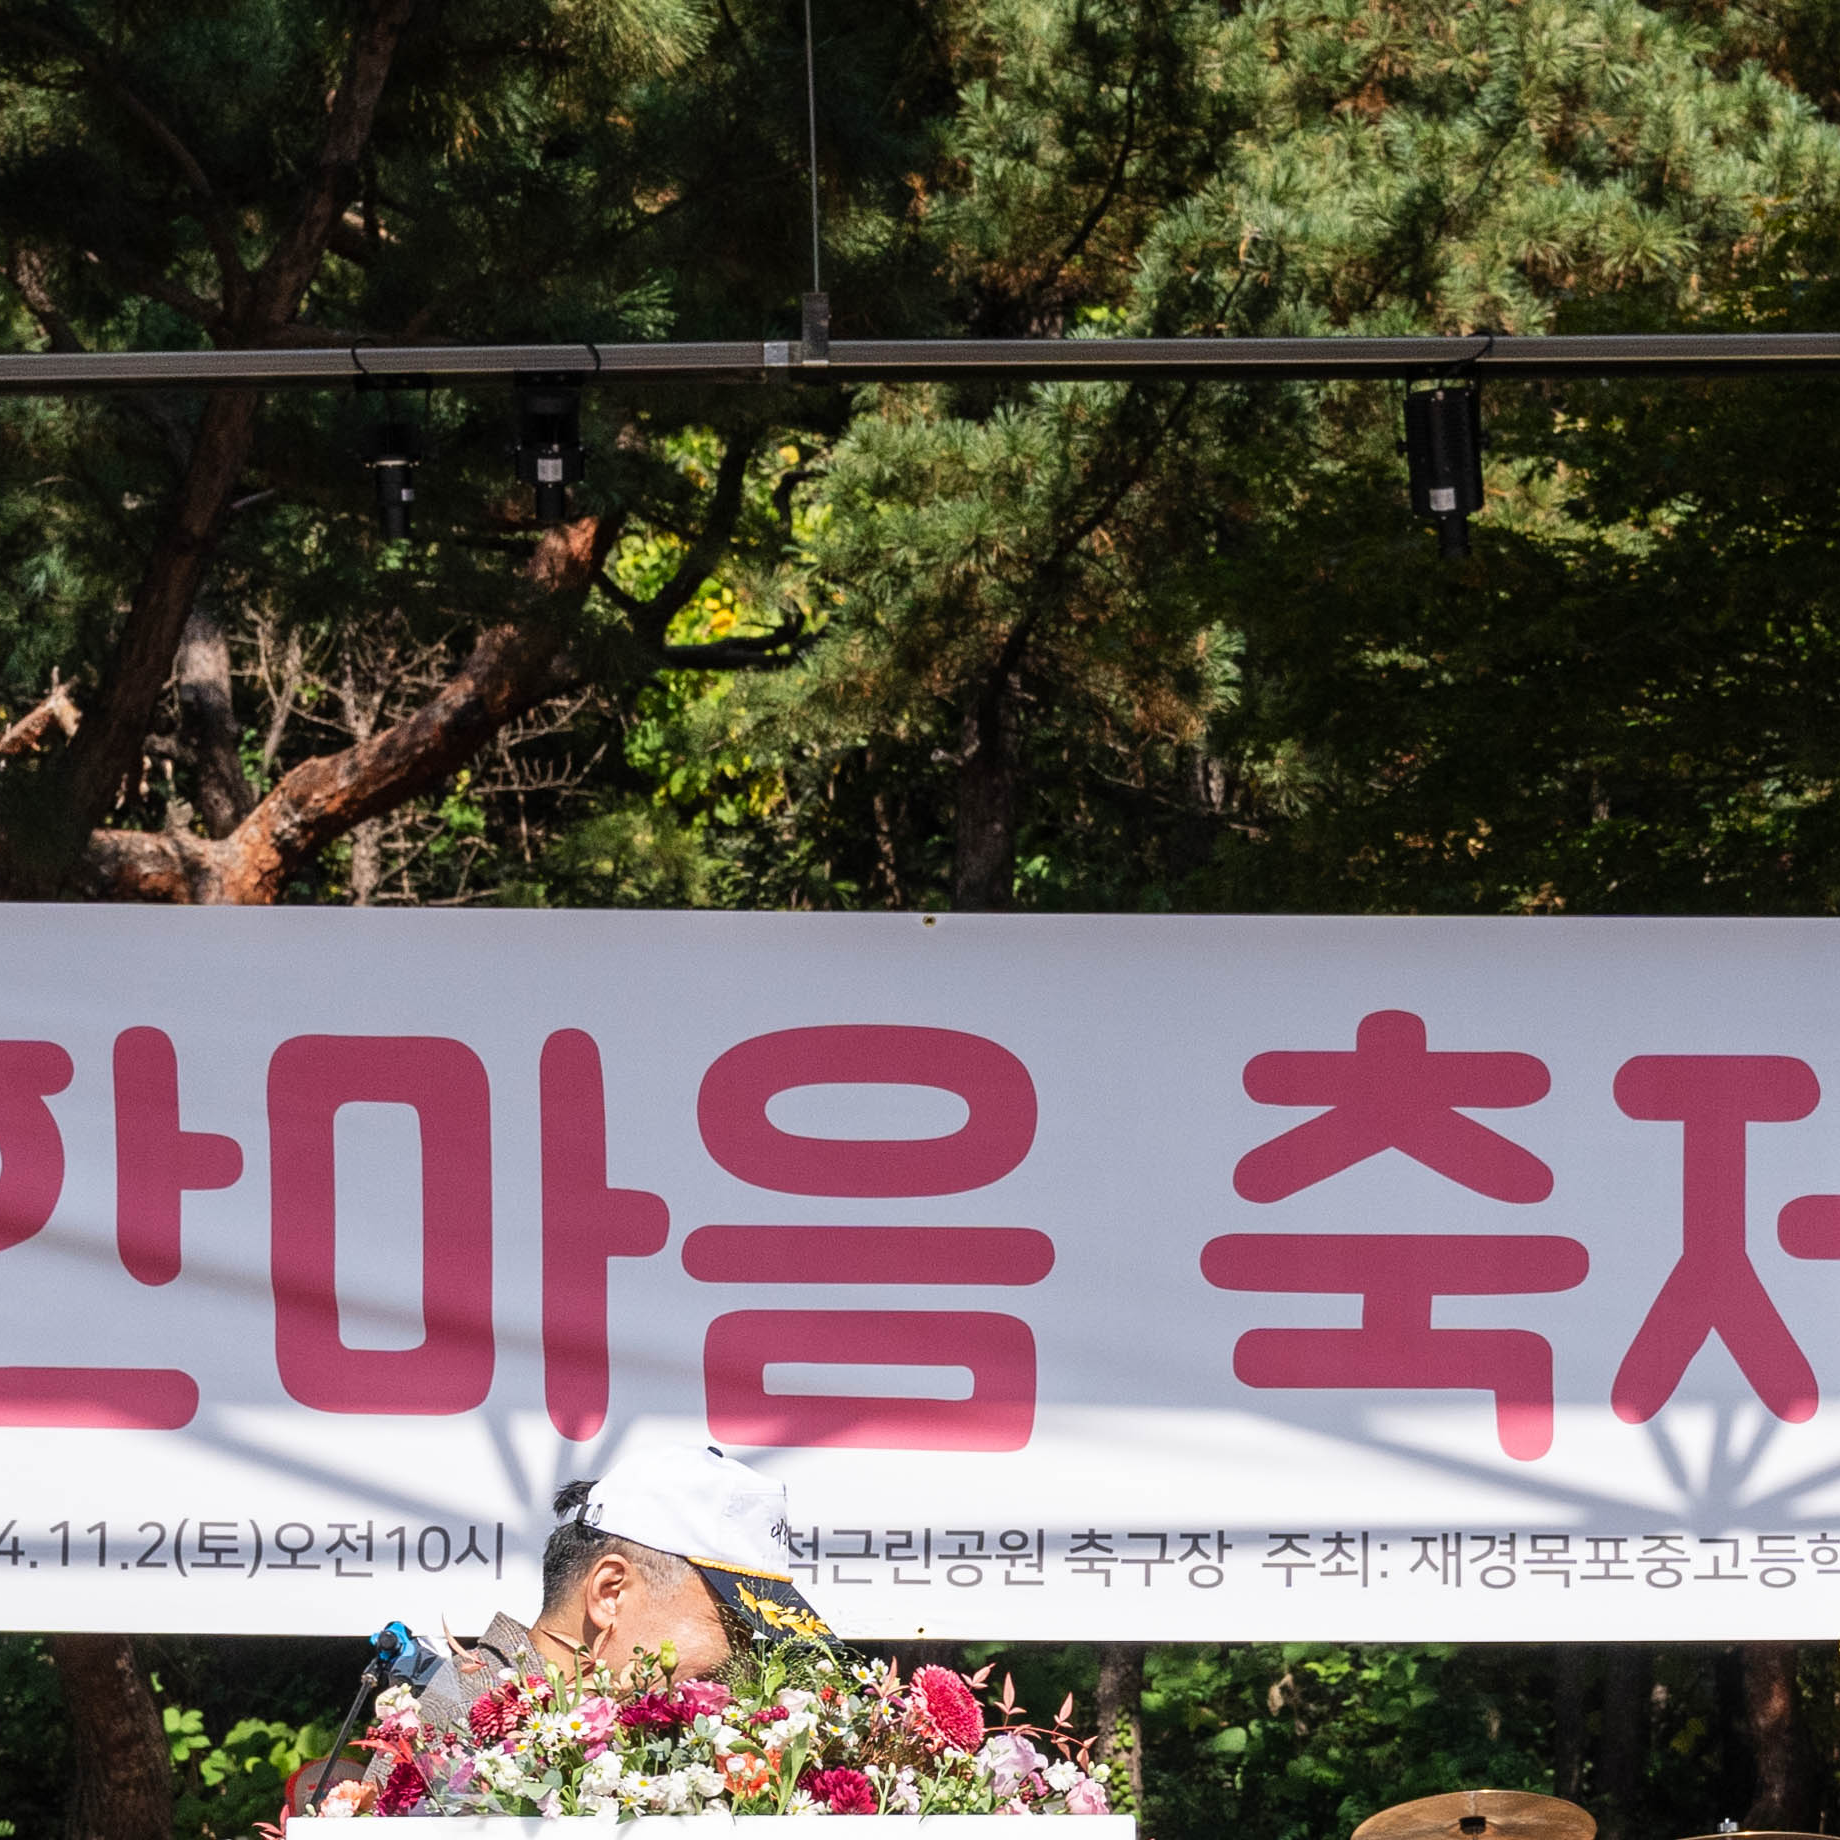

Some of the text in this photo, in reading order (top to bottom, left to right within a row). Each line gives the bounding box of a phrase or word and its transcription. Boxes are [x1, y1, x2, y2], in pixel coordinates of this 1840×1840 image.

[788, 1525, 1046, 1590] 척근린공원
[1063, 1528, 1234, 1590] 축구장
[1260, 1529, 1390, 1590] 주최:
